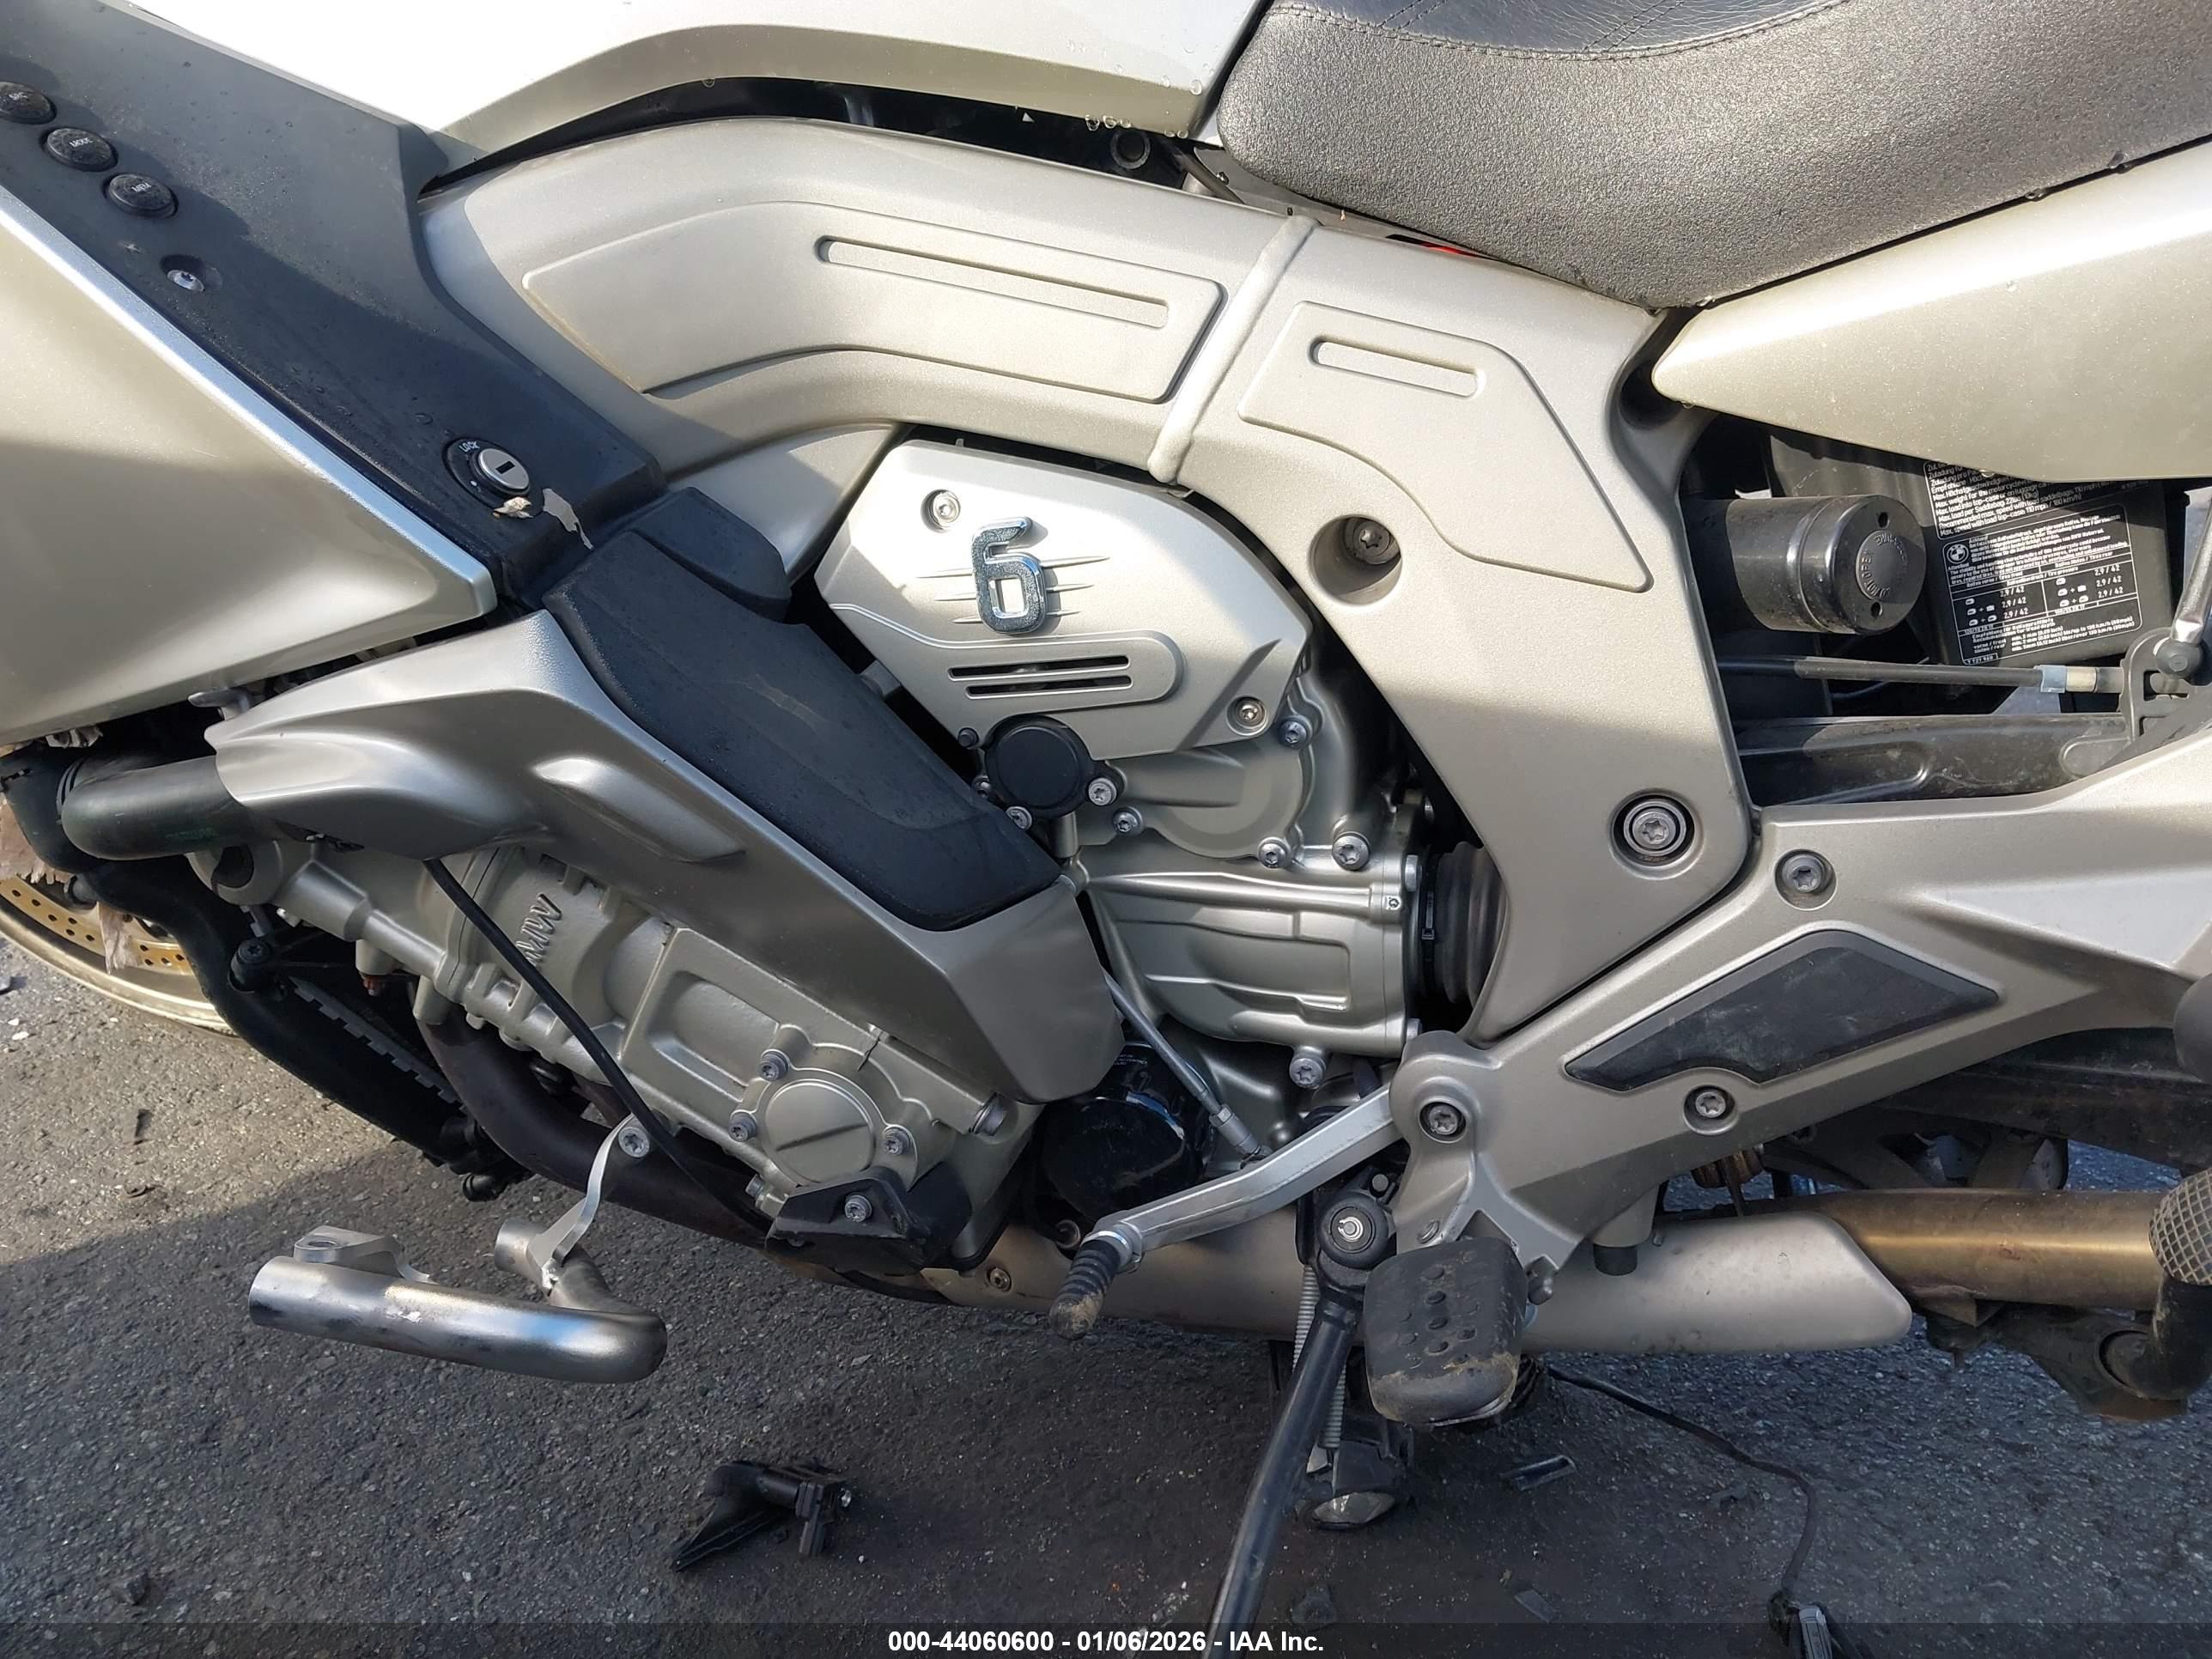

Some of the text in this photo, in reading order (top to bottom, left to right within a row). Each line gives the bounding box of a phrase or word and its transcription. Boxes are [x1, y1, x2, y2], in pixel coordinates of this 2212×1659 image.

[459, 441, 481, 453] LOCK
[1938, 513, 1981, 530] Recommended
[2110, 563, 2121, 573] 42
[972, 516, 1046, 634] 6
[2112, 574, 2122, 584] 42
[2014, 585, 2025, 594] 42
[2113, 586, 2124, 594] 42
[2016, 595, 2027, 605] 42
[2018, 606, 2028, 616] 42
